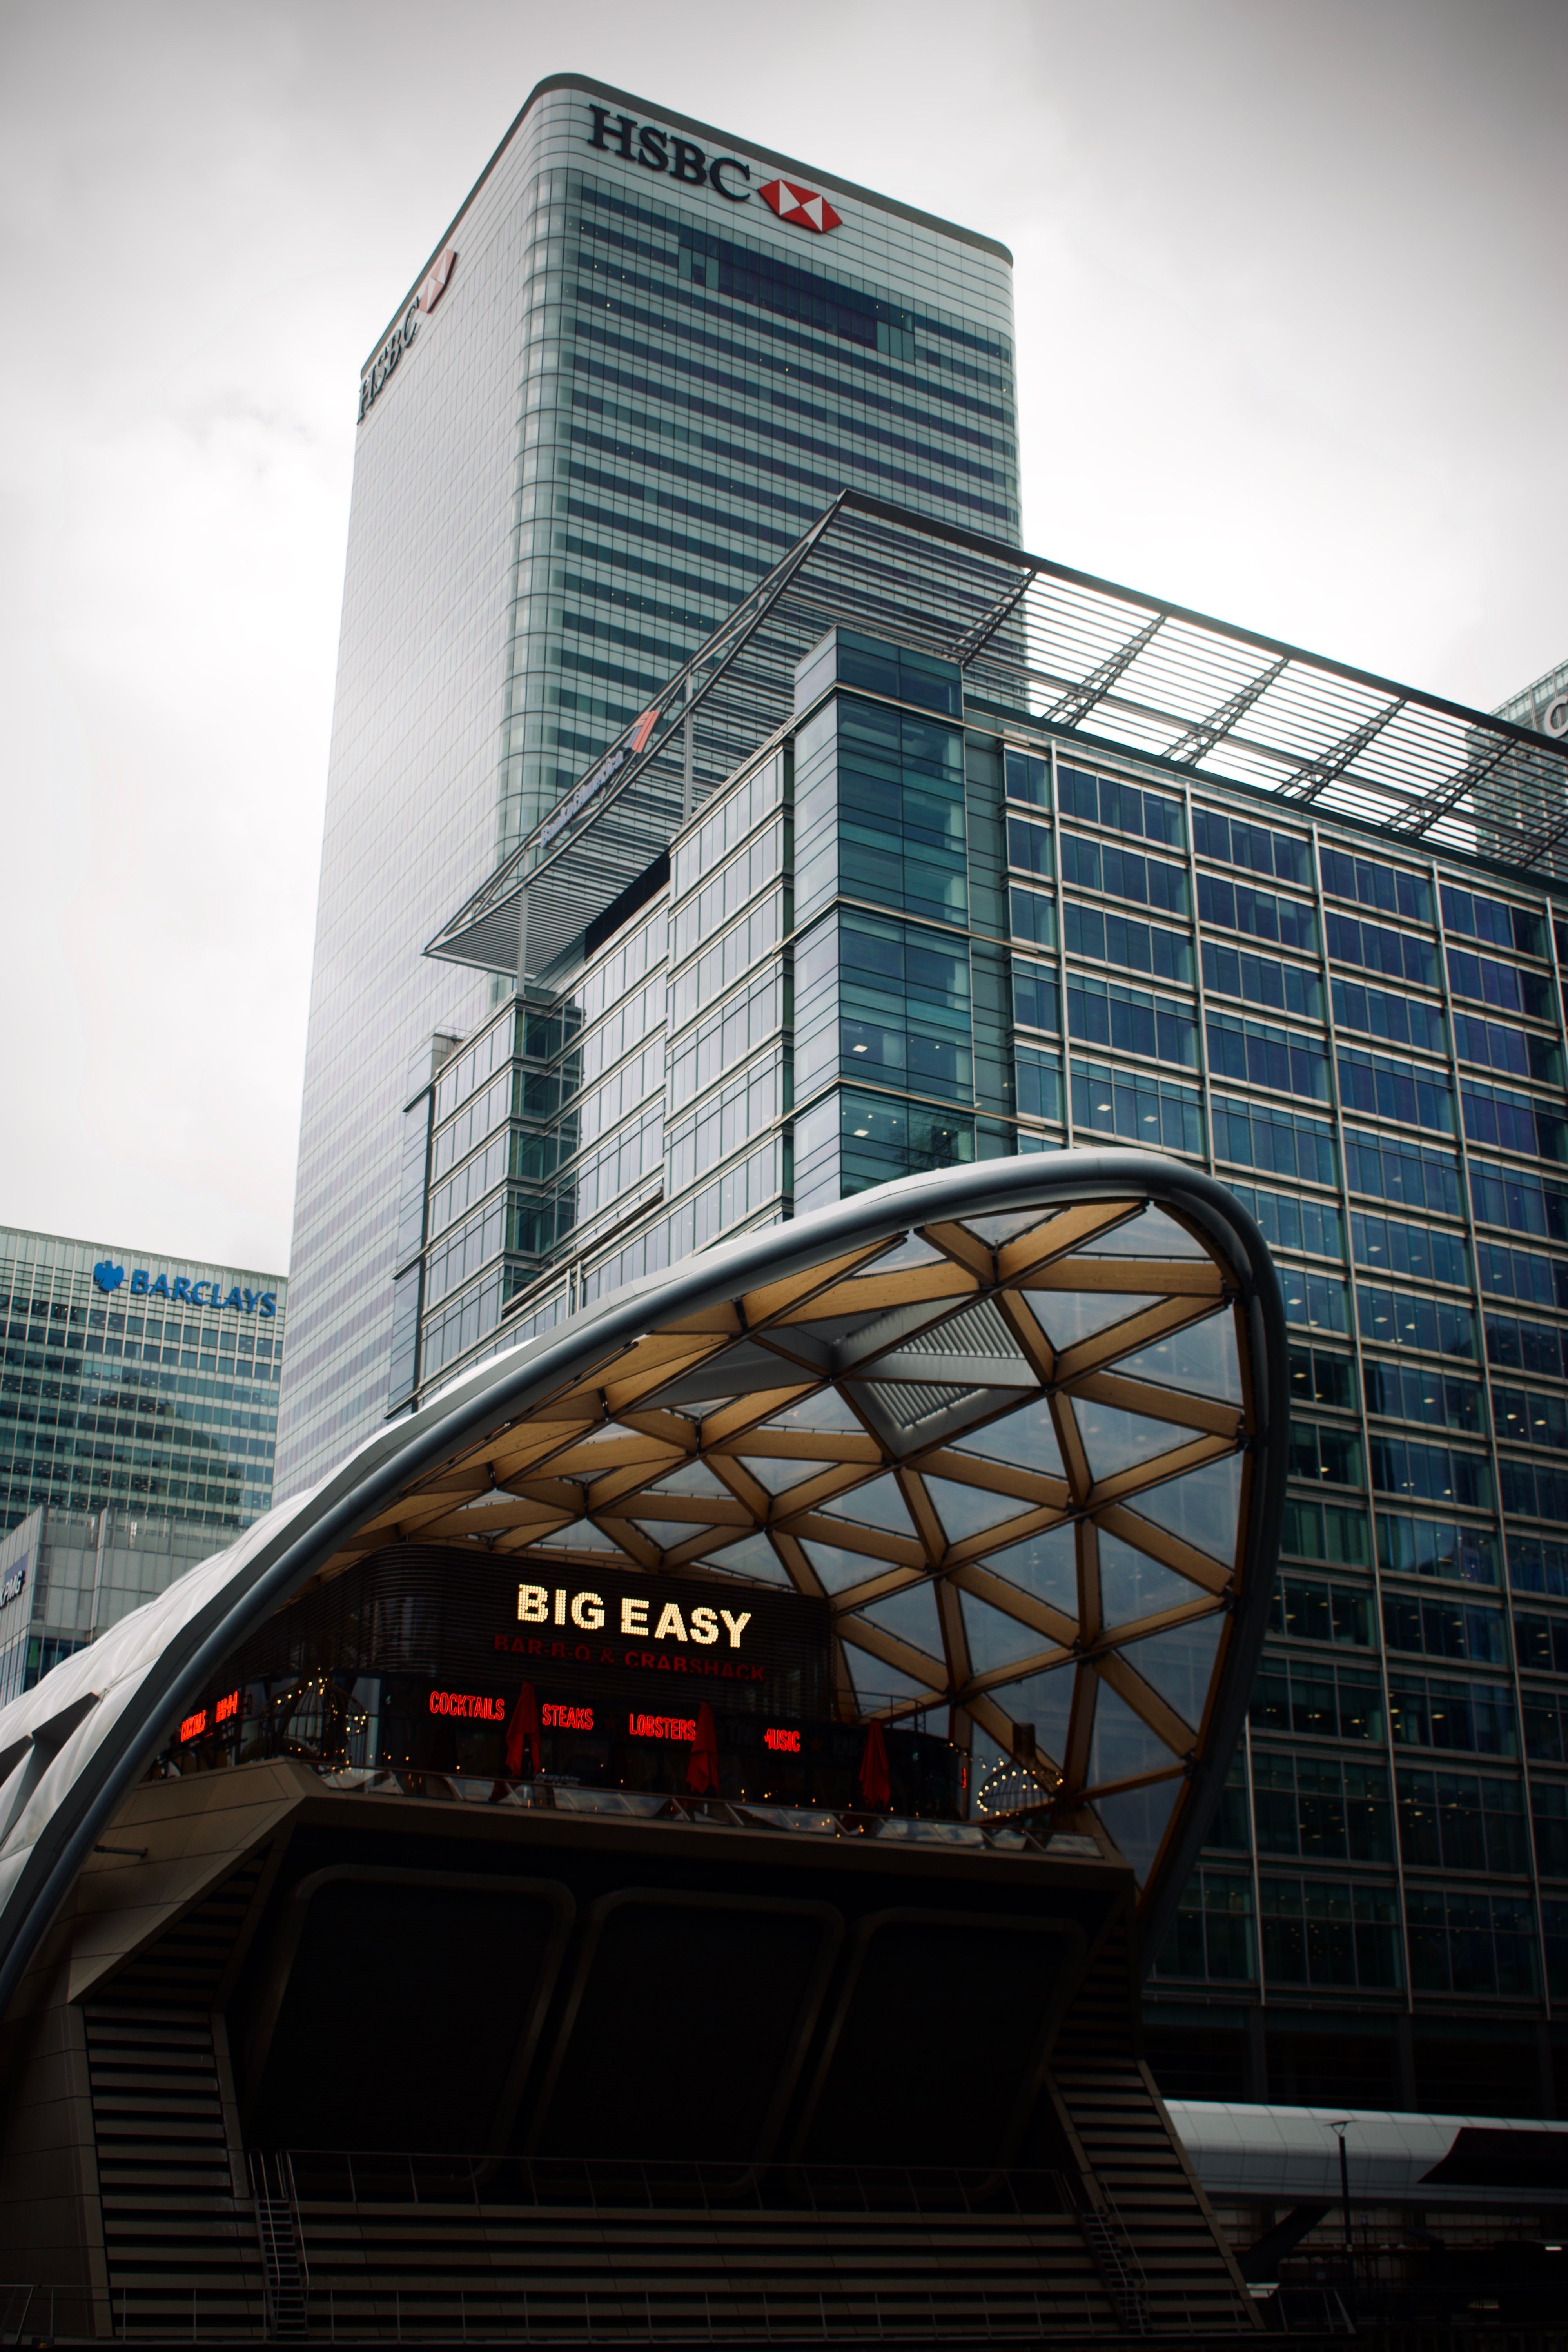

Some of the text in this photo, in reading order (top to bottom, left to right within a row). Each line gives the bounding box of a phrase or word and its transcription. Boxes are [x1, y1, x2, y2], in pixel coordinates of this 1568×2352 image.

[587, 103, 751, 202] HSBC
[356, 296, 421, 426] HSBC
[131, 1269, 277, 1317] BARCLAYS
[517, 1584, 751, 1648] BIG EASY
[494, 1634, 765, 1682] BAR-B-Q & CRABSHACK
[430, 1691, 505, 1720] COCKTAILS
[542, 1703, 593, 1730] STEAKS
[629, 1713, 696, 1741] LOBSTERS
